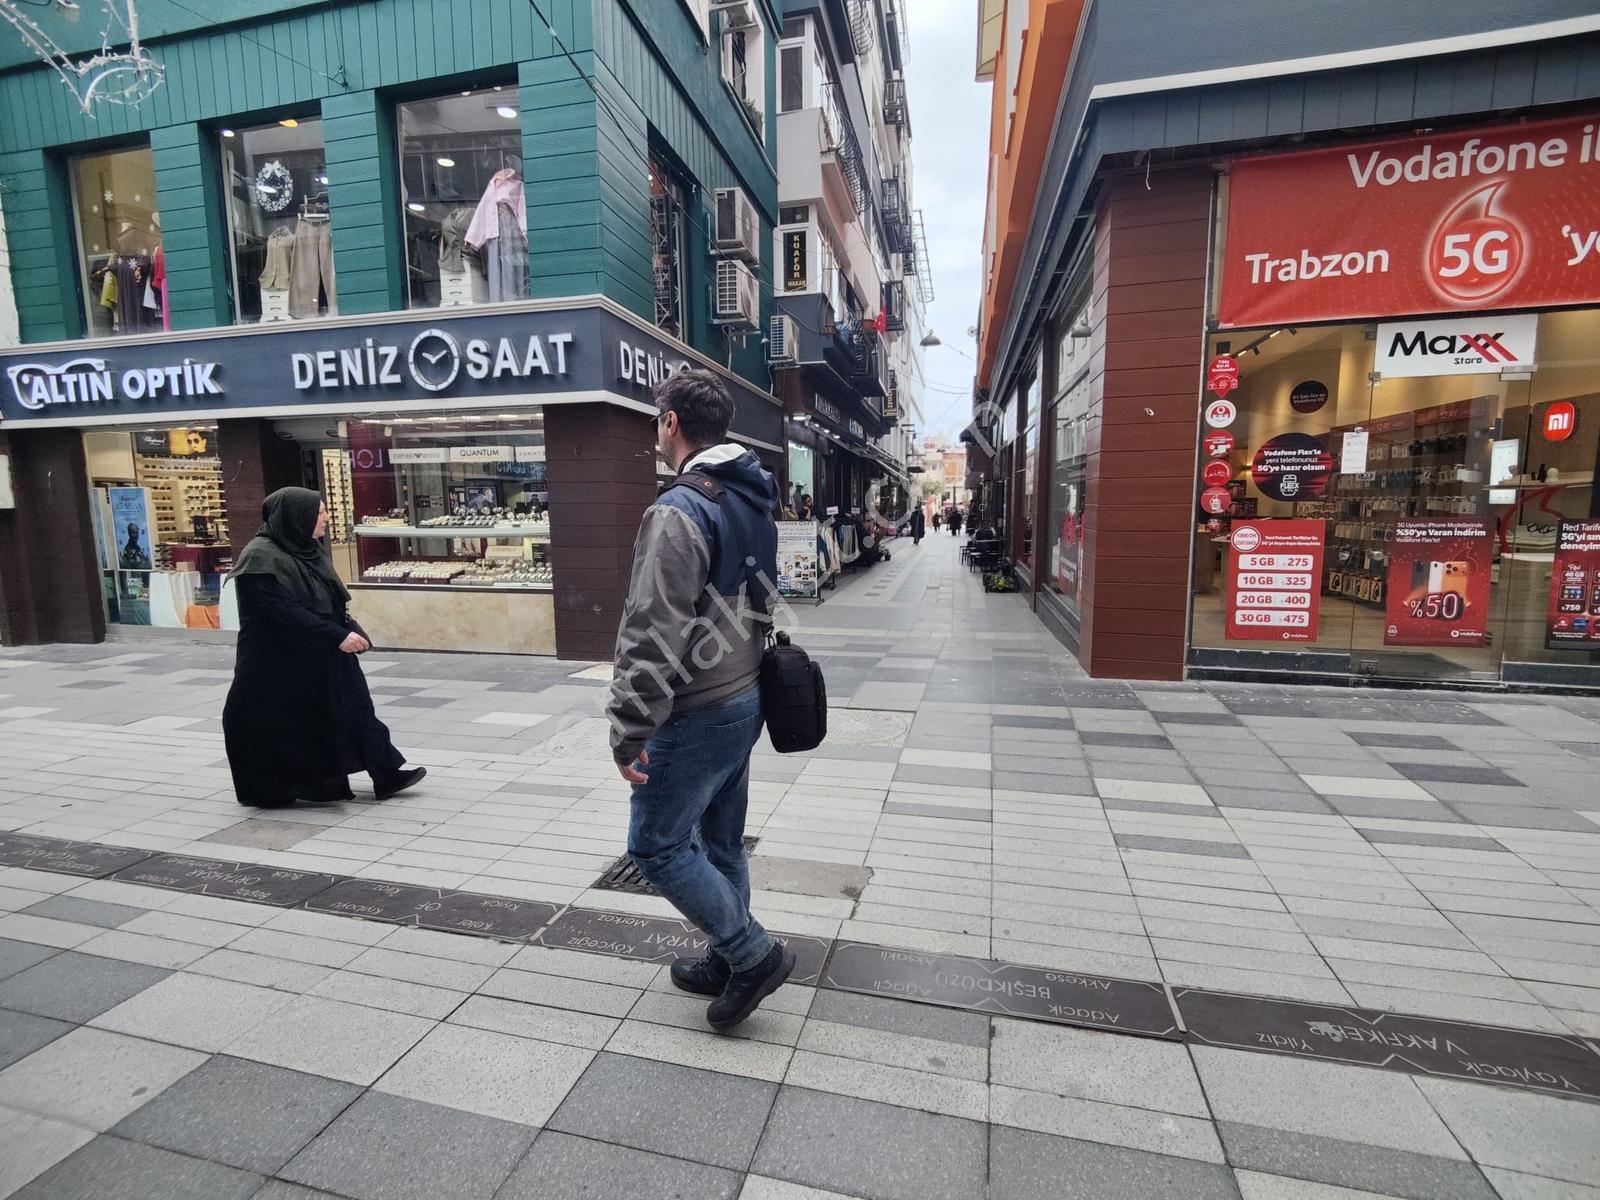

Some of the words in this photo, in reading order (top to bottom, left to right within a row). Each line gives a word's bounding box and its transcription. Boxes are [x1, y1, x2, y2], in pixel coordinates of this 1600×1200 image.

[1347, 137, 1567, 189] Vodafone
[1245, 249, 1390, 284] Trabzon
[1438, 230, 1509, 278] 5G
[291, 338, 402, 390] DENİZ
[465, 332, 573, 381] SAAT
[31, 371, 114, 404] ALTIN
[122, 357, 220, 400] OPTİK
[460, 449, 499, 458] QUANTUM
[1258, 465, 1280, 473] 5G'ye
[1281, 464, 1302, 472] hazır
[1454, 527, 1486, 537] İndirim
[1562, 523, 1579, 531] Red
[1250, 557, 1257, 566] 5
[1259, 557, 1275, 566] GB
[1243, 576, 1256, 585] 10
[1258, 576, 1274, 585] GB
[1241, 595, 1255, 603] 20
[1257, 595, 1273, 604] GB
[1410, 593, 1458, 618] %50
[1240, 614, 1254, 622] 30
[1256, 614, 1271, 622] GB
[414, 901, 442, 912] OF
[596, 915, 650, 928] Merkez
[1044, 972, 1112, 991] Akkese
[1047, 1004, 1120, 1024] Adacık
[1253, 1031, 1313, 1052] Yıldız
[1456, 1059, 1579, 1091] Yaylacık
